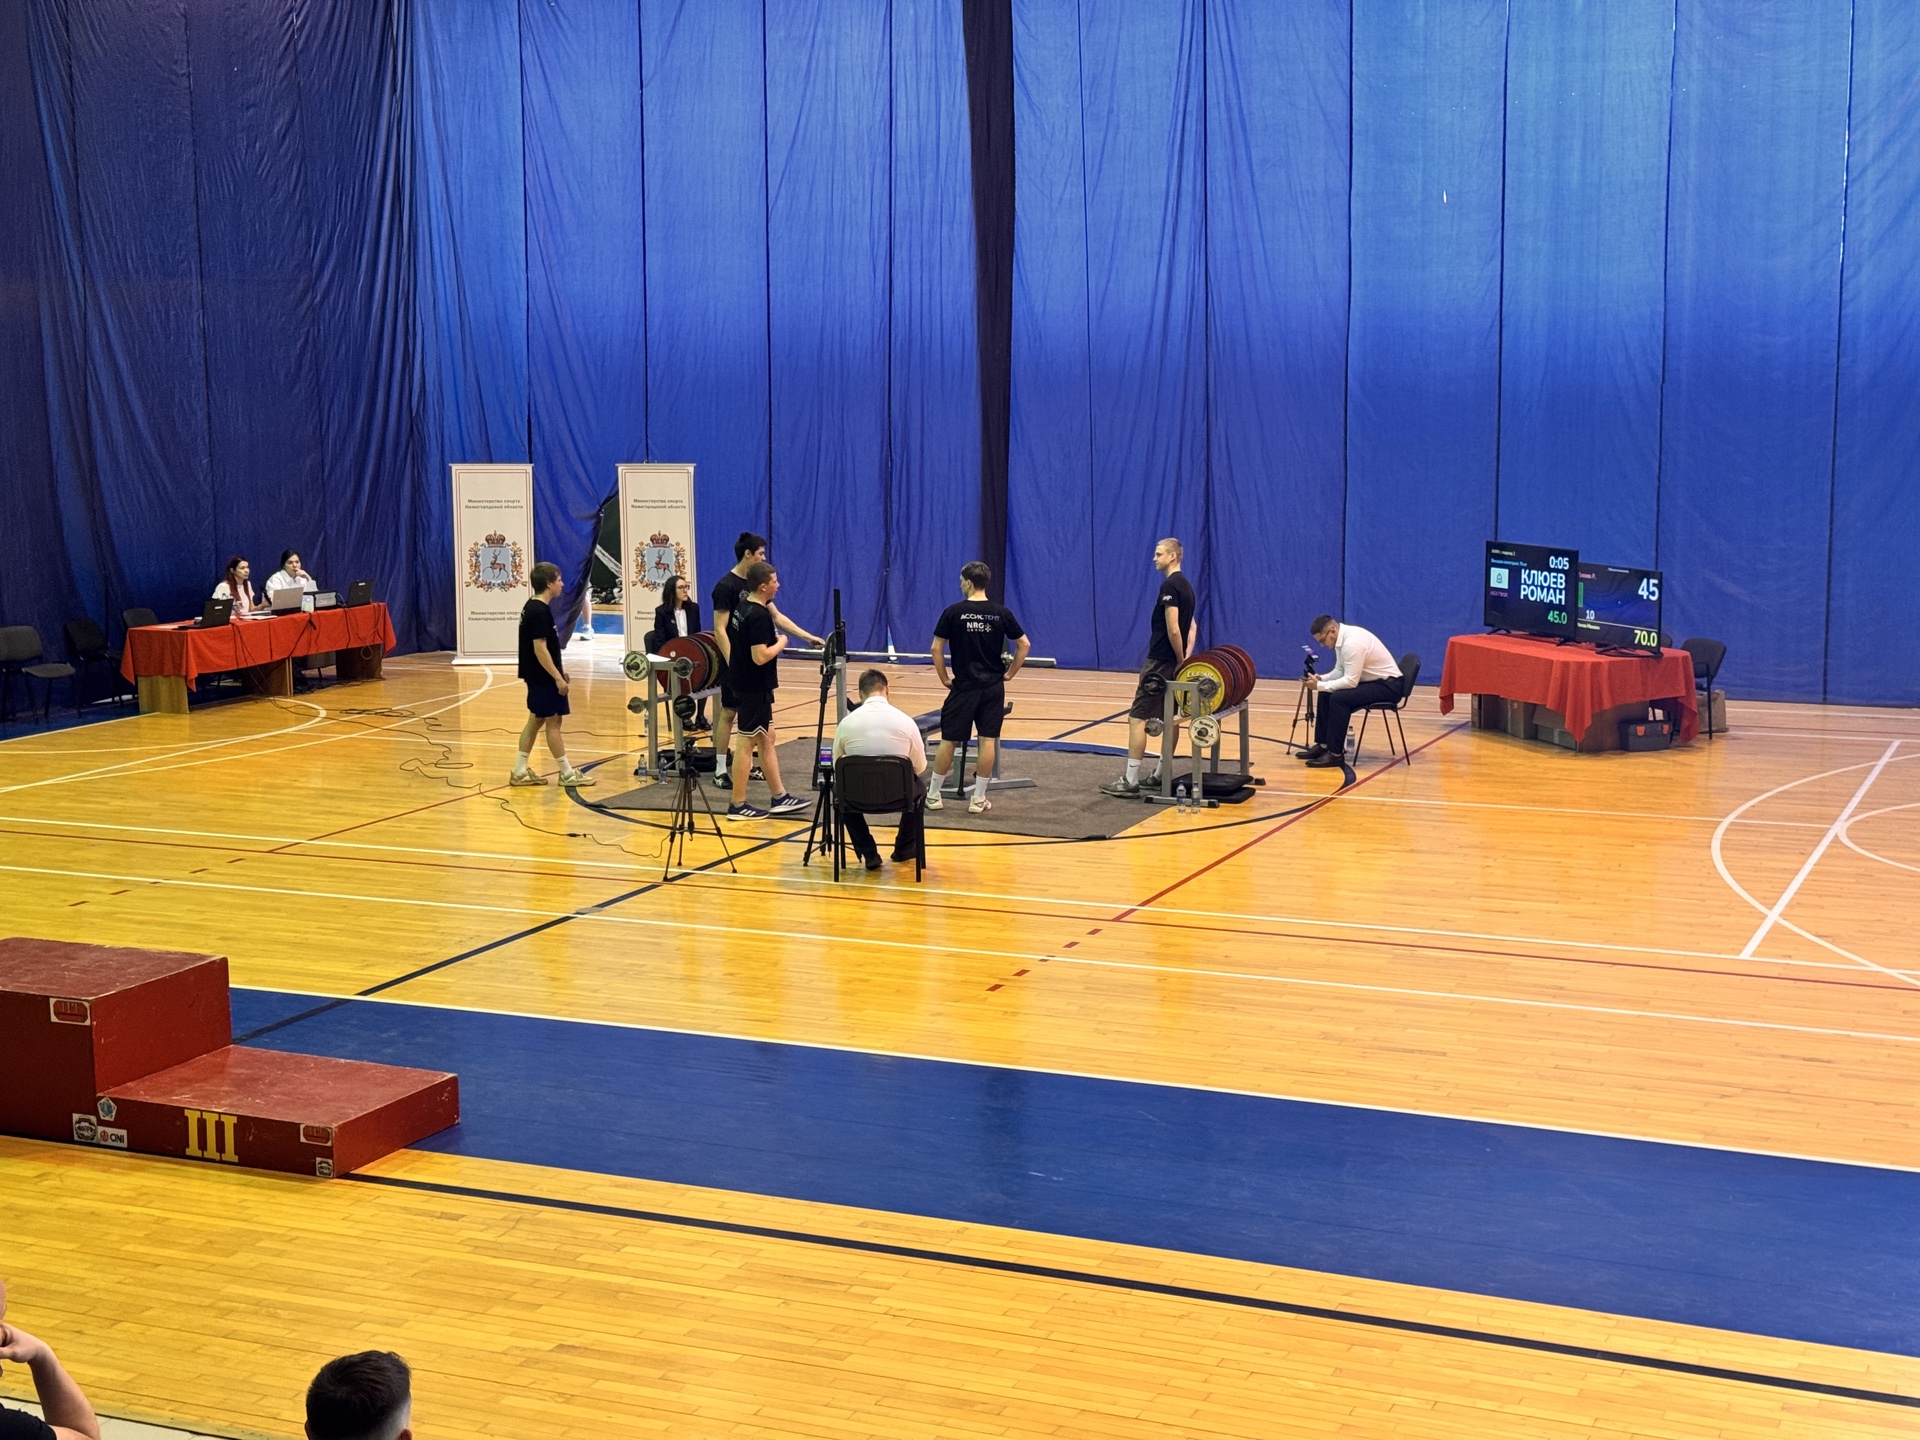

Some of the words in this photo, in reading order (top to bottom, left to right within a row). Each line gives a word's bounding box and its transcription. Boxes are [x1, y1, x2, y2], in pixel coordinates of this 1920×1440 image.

[1549, 556, 1570, 570] 0:05
[1521, 568, 1566, 588] КЛЮЕВ
[1520, 584, 1566, 605] РОМАН
[1638, 578, 1659, 600] 45
[1548, 610, 1568, 624] 45.0
[1586, 610, 1595, 620] 10
[1634, 630, 1658, 646] 70.0
[184, 1109, 238, 1162] III
